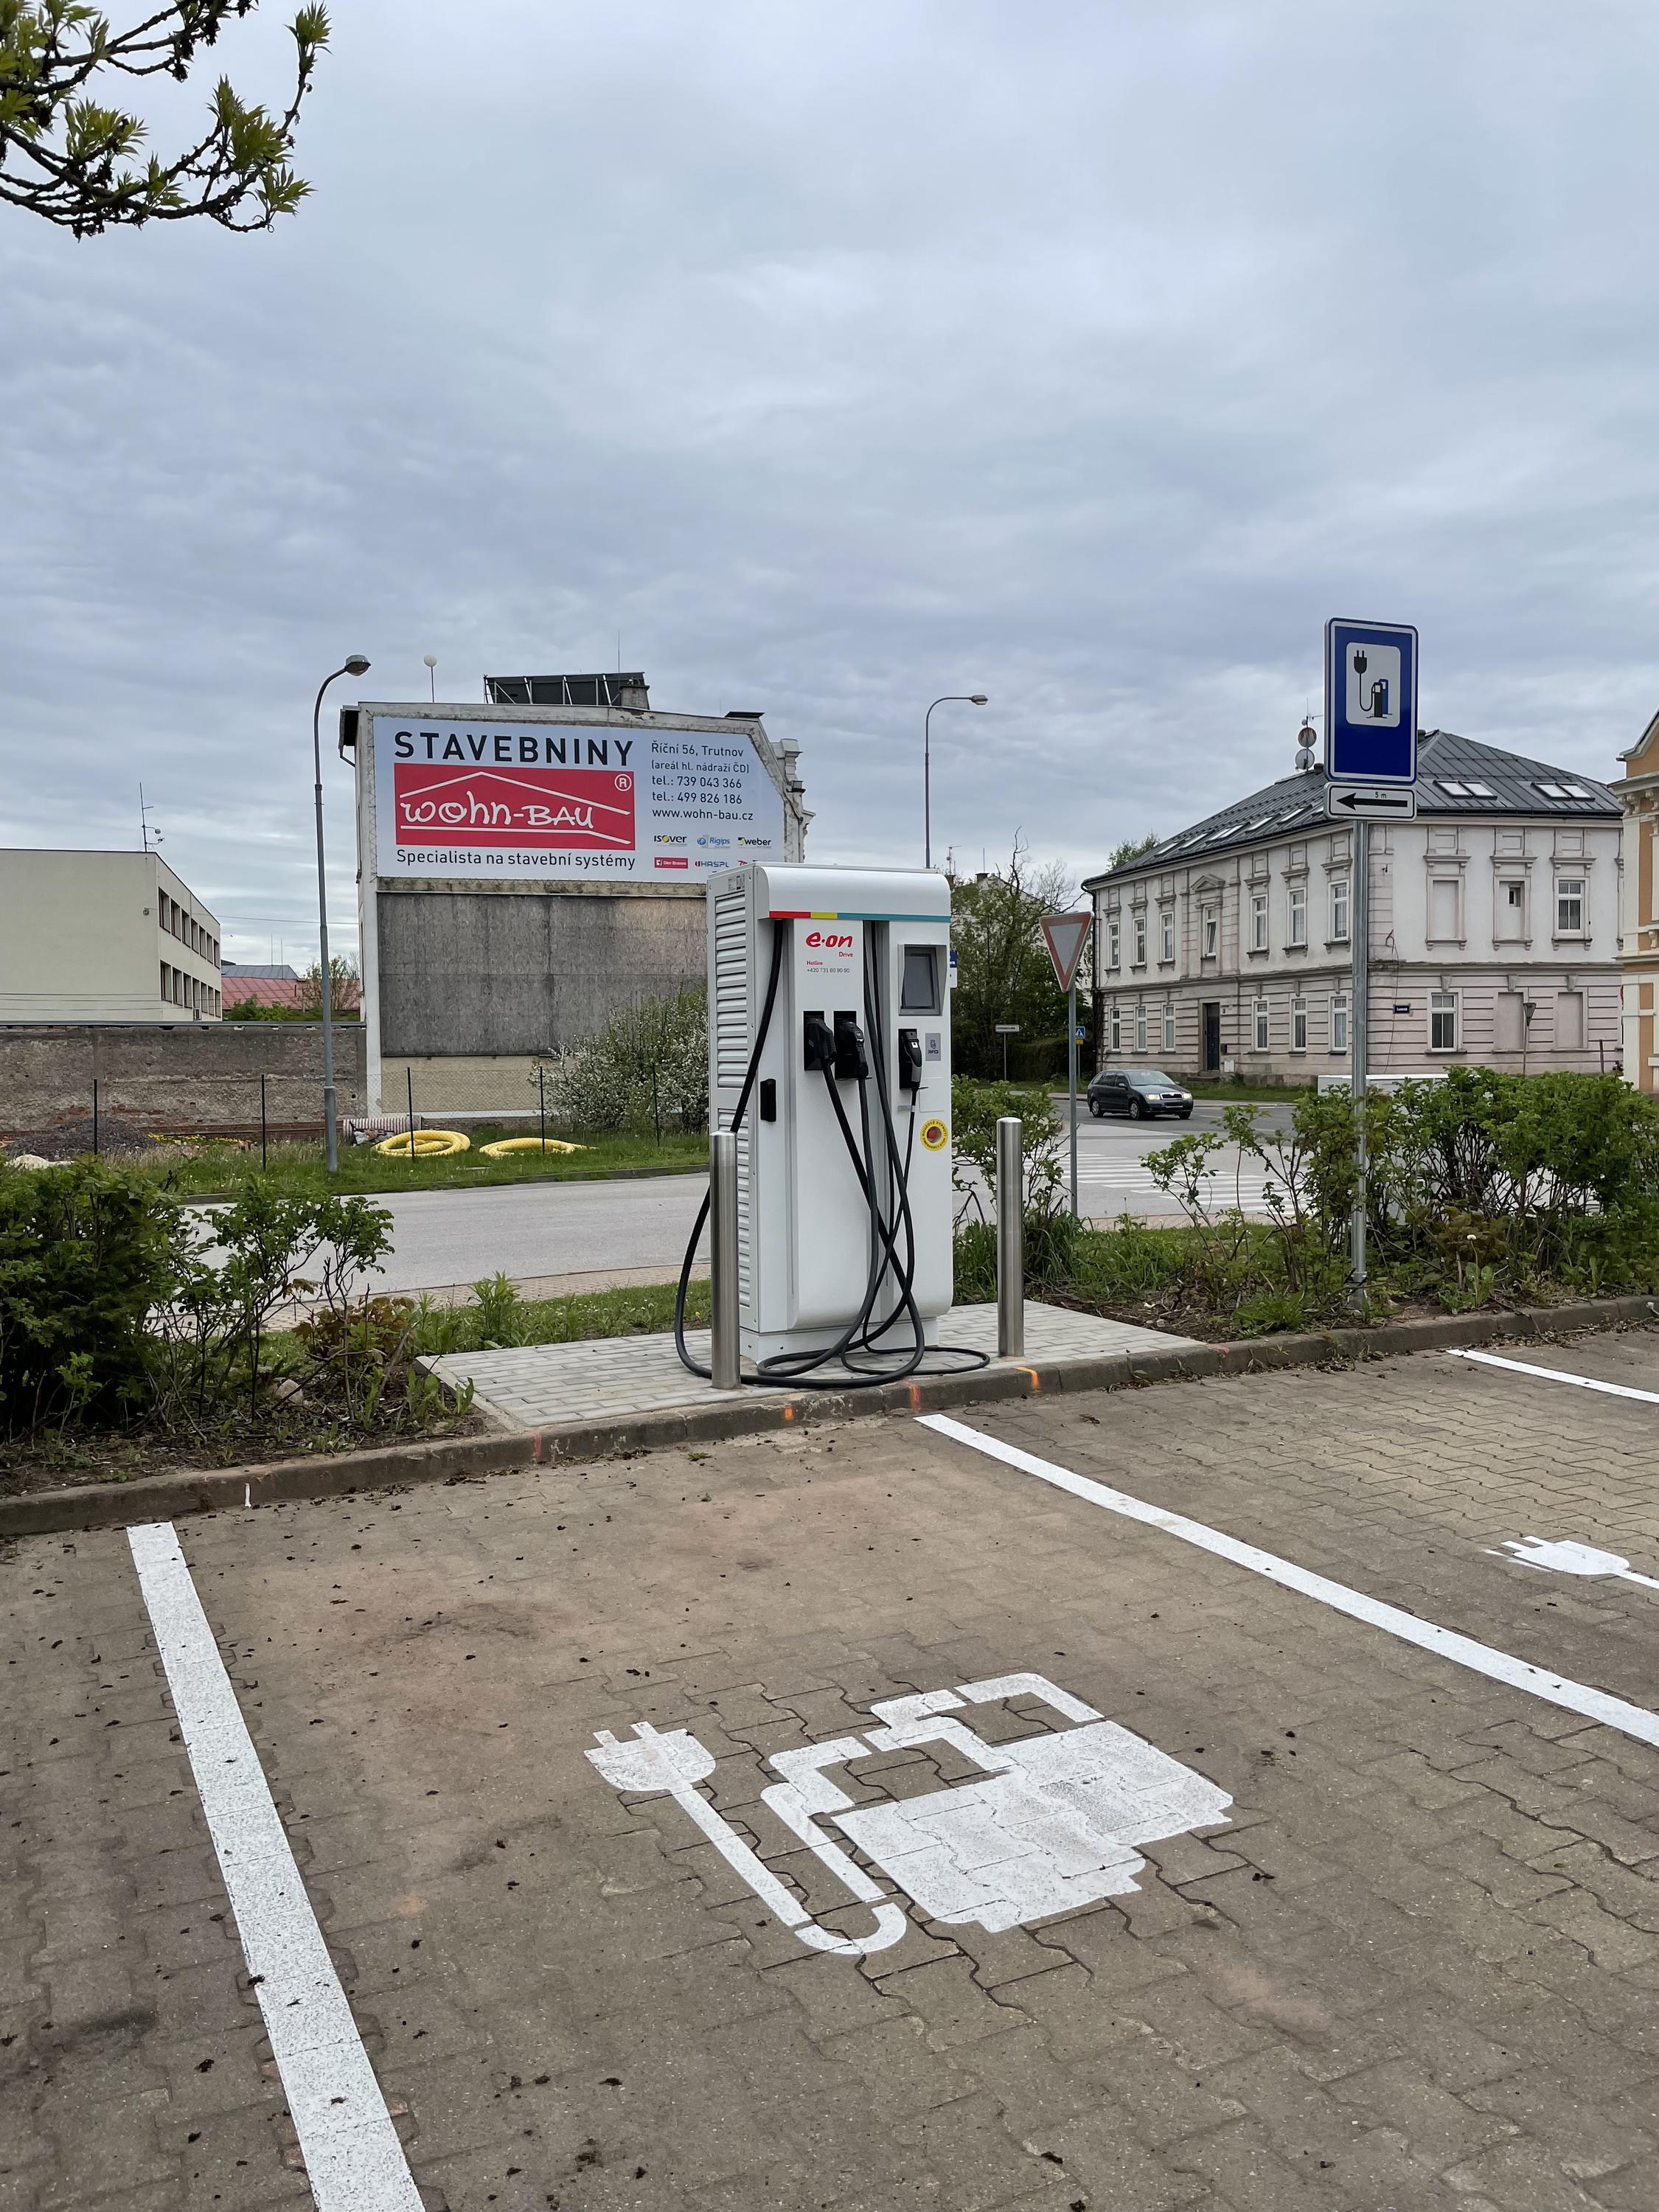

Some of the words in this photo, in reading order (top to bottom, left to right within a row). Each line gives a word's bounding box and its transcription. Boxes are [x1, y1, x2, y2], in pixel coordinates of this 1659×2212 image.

[394, 731, 634, 766] STAVEBNINY
[651, 740, 679, 754] Říční
[683, 745, 698, 757] 56,
[702, 745, 744, 757] Trutnov
[651, 759, 679, 770] (areál
[681, 760, 694, 771] hl.
[696, 762, 731, 773] nádraží
[733, 762, 749, 773] ČD)
[652, 776, 674, 786] tel.:
[677, 776, 697, 787] 739
[700, 777, 720, 787] 043
[723, 779, 742, 788] 366
[652, 792, 674, 801] tel.:
[677, 793, 697, 802] 499
[700, 793, 720, 804] 826
[723, 794, 742, 804] 186
[400, 790, 594, 830] wohn-BAU
[652, 809, 754, 821] www.wohn-bau.cz
[709, 837, 731, 846] Rigips
[745, 837, 772, 846] weber
[397, 849, 481, 866] Specialista
[487, 854, 504, 865] na
[508, 852, 571, 866] stavební
[575, 854, 636, 871] systémy
